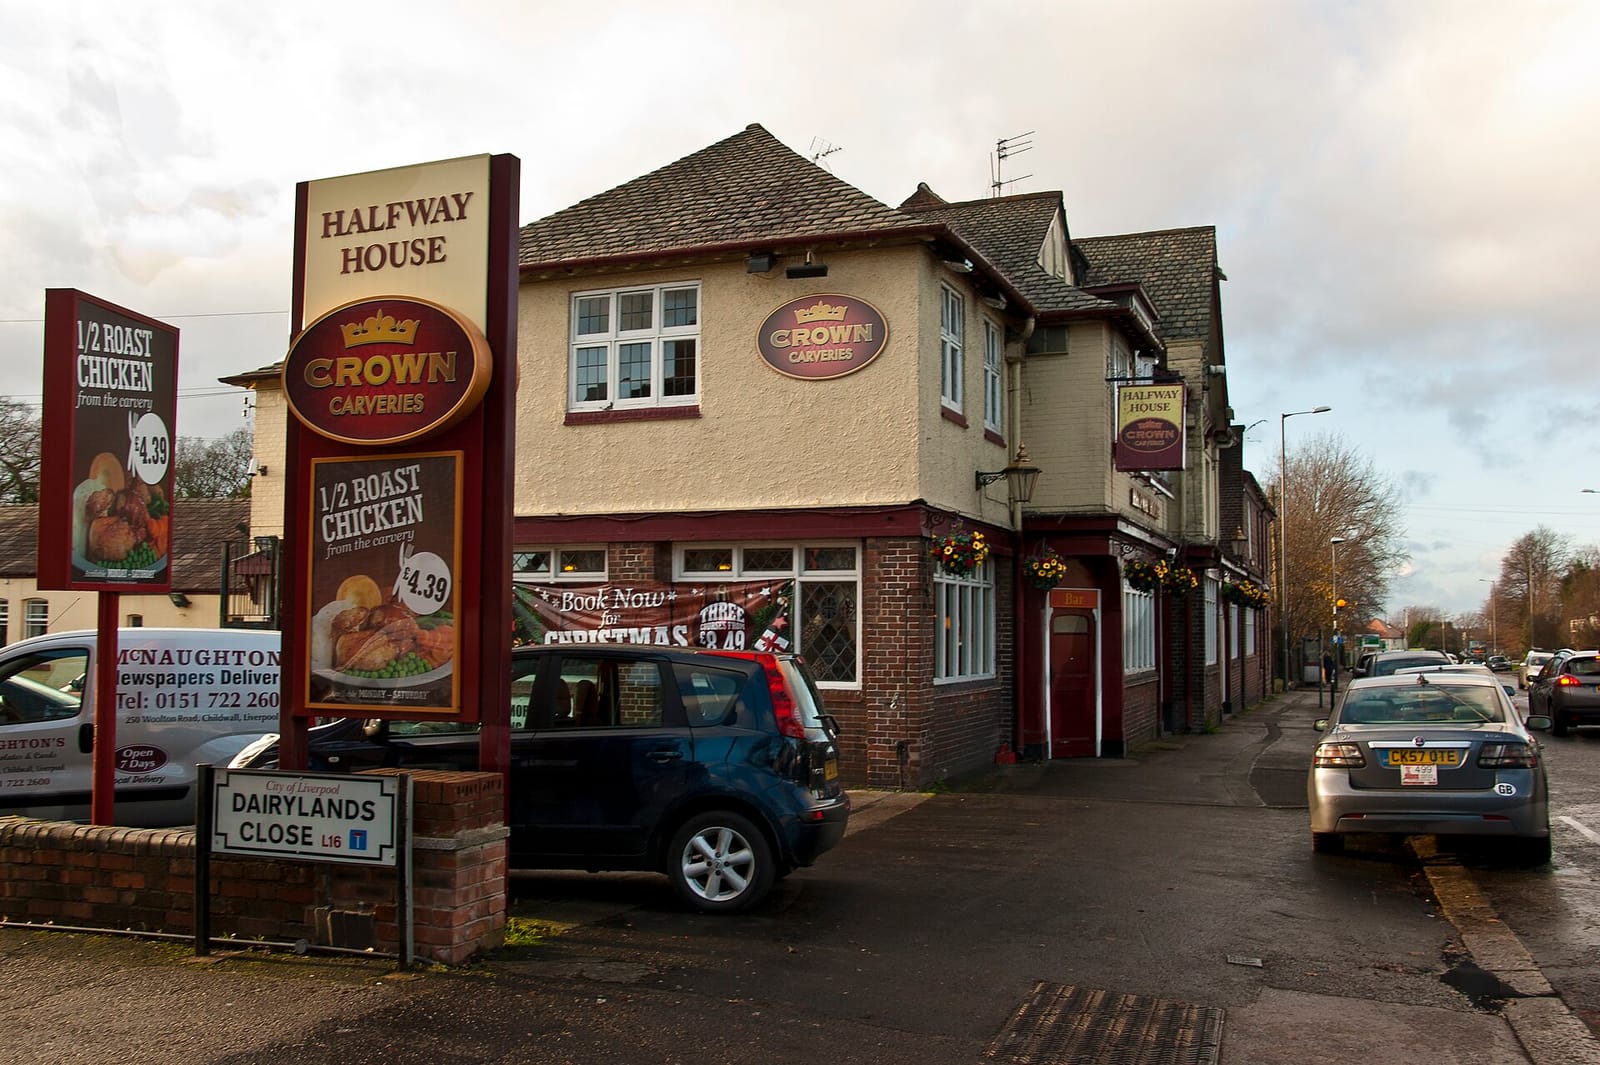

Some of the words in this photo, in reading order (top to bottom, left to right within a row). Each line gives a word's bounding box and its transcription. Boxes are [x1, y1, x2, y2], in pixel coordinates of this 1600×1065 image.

[320, 191, 474, 239] HALFWAY
[339, 236, 447, 275] HOUSE
[77, 320, 100, 353] 1/2
[103, 323, 152, 357] ROAST
[770, 323, 873, 348] CROWN
[788, 348, 853, 364] CARVERIES
[77, 354, 153, 392] CHICKEN
[303, 351, 457, 388] CROWN
[75, 390, 101, 408] from
[103, 391, 118, 407] the
[119, 397, 153, 412] carvery
[329, 393, 425, 416] CARVERIES
[1122, 389, 1179, 401] HALFWAY
[1129, 402, 1171, 412] HOUSE
[1126, 430, 1174, 439] CROWN
[134, 435, 168, 466] £4.39
[320, 482, 349, 513] 1/2
[352, 464, 420, 504] ROAST
[322, 493, 423, 543] CHICKEN
[325, 543, 352, 560] from
[354, 537, 371, 550] the
[372, 530, 414, 546] carvery
[402, 565, 448, 604] £4.39
[560, 588, 608, 612] Book
[612, 587, 665, 609] Now
[1065, 592, 1084, 605] Bar
[599, 610, 621, 628] for
[700, 602, 745, 624] THREE
[116, 691, 148, 709] Tel:
[155, 692, 199, 709] 0151
[208, 692, 241, 708] 722
[246, 691, 280, 708] 260
[243, 711, 279, 723] Liverpool
[120, 760, 129, 769] 7
[129, 759, 156, 770] Days
[122, 749, 154, 760] Open
[1391, 750, 1426, 762] CK57
[266, 780, 284, 793] City
[286, 782, 297, 794] of
[298, 782, 341, 795] Liverpool
[1498, 784, 1513, 795] GB
[232, 793, 376, 821] DAIRYLANDS
[240, 822, 313, 846] CLOSE
[321, 834, 342, 848] L16
